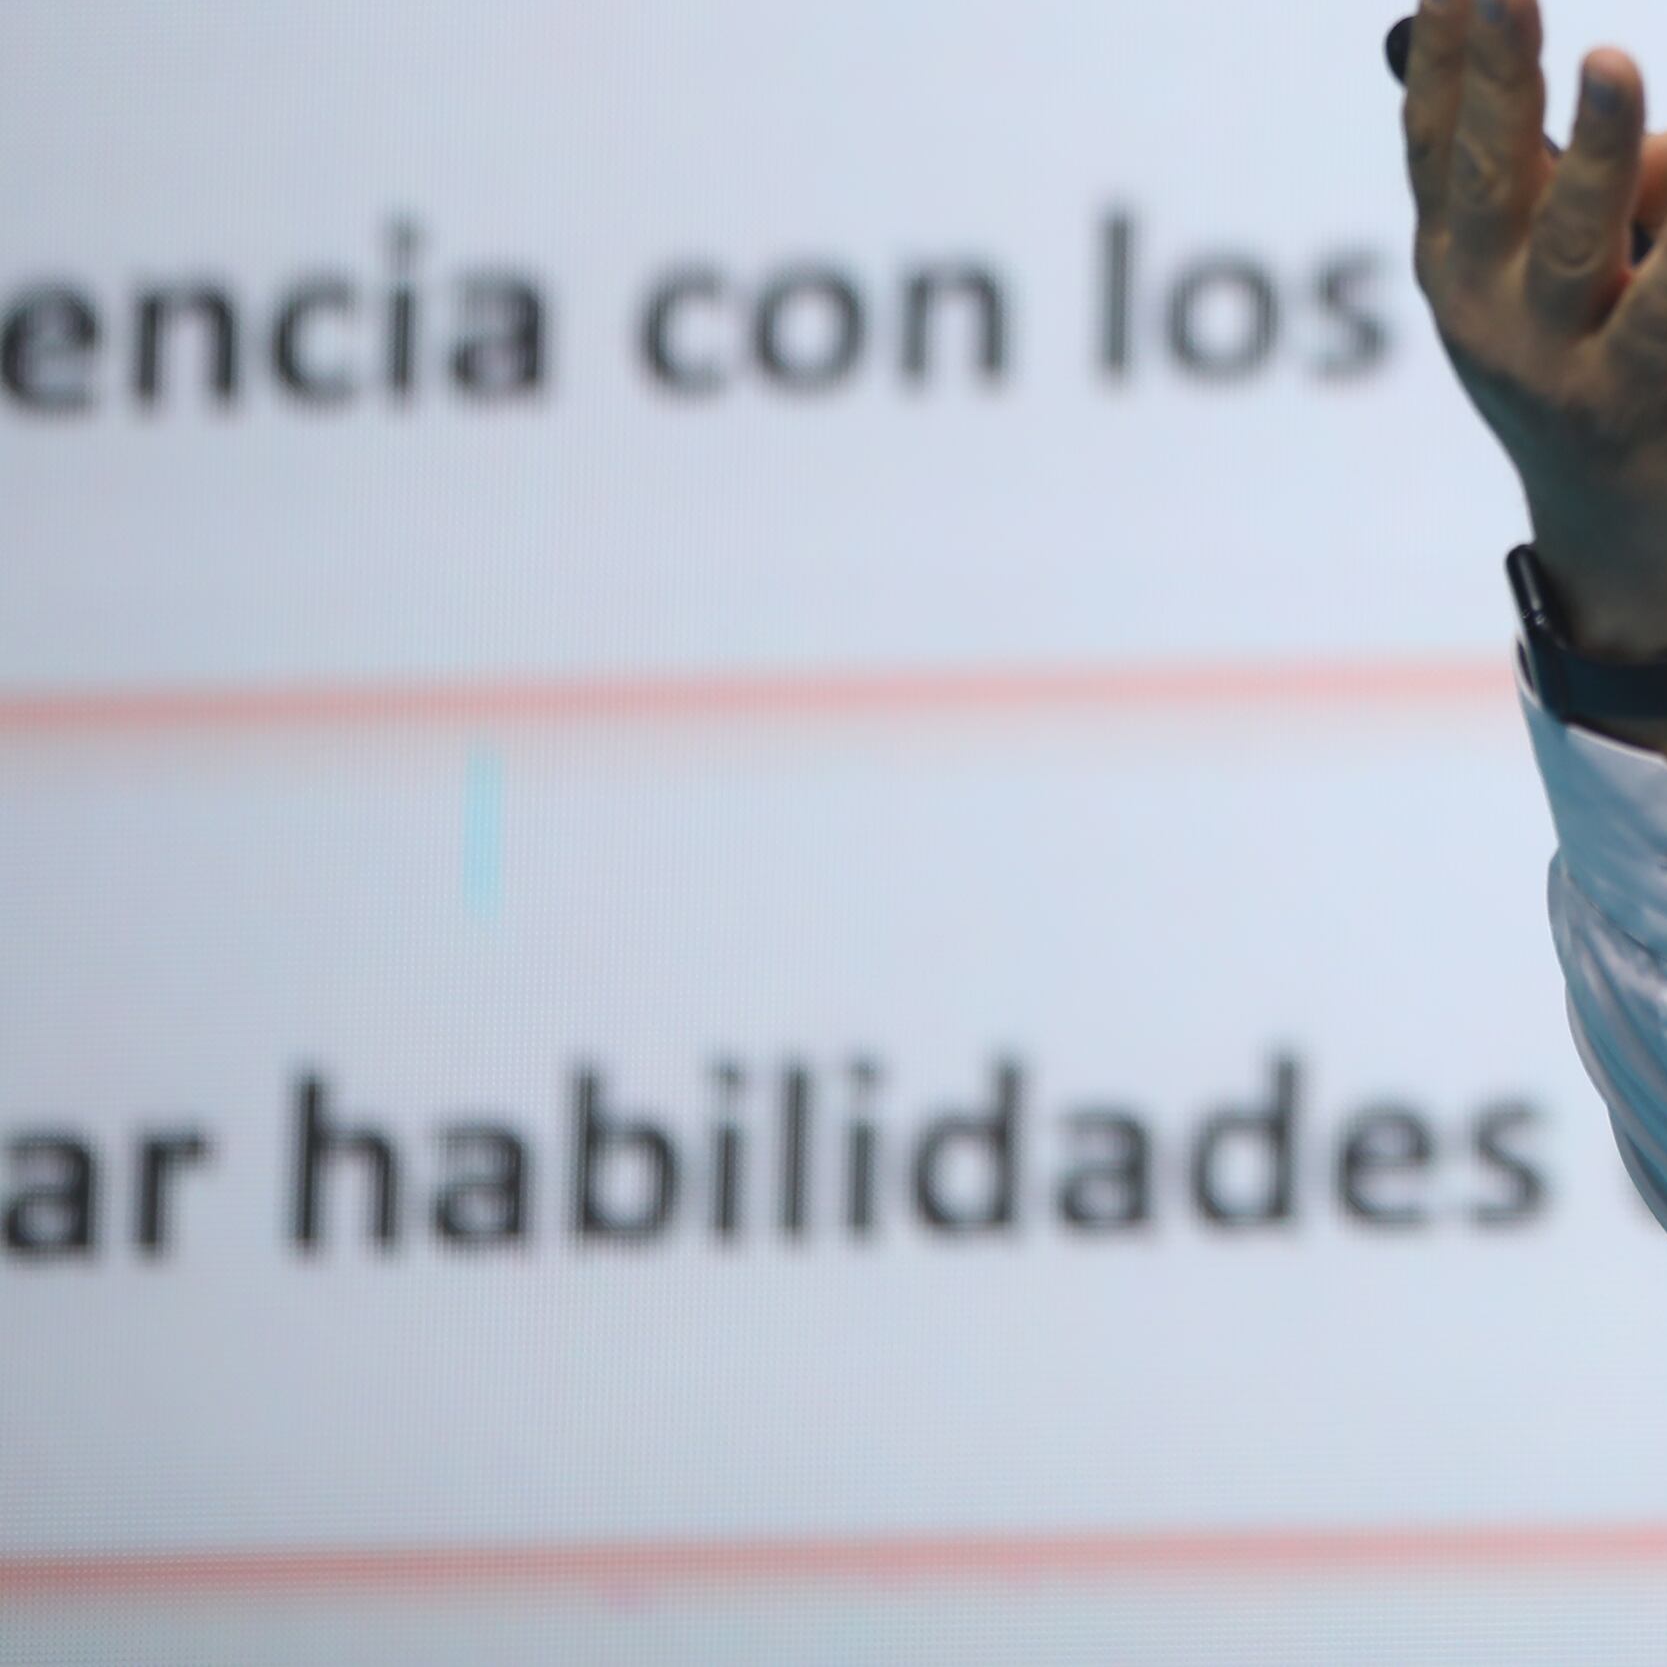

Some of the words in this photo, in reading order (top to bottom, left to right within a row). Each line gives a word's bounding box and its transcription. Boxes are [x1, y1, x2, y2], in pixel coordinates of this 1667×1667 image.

[0, 222, 550, 418] encia
[632, 256, 1012, 400] con
[1092, 202, 1386, 386] los
[0, 1124, 212, 1266] ar
[282, 1050, 1550, 1264] habilidades
